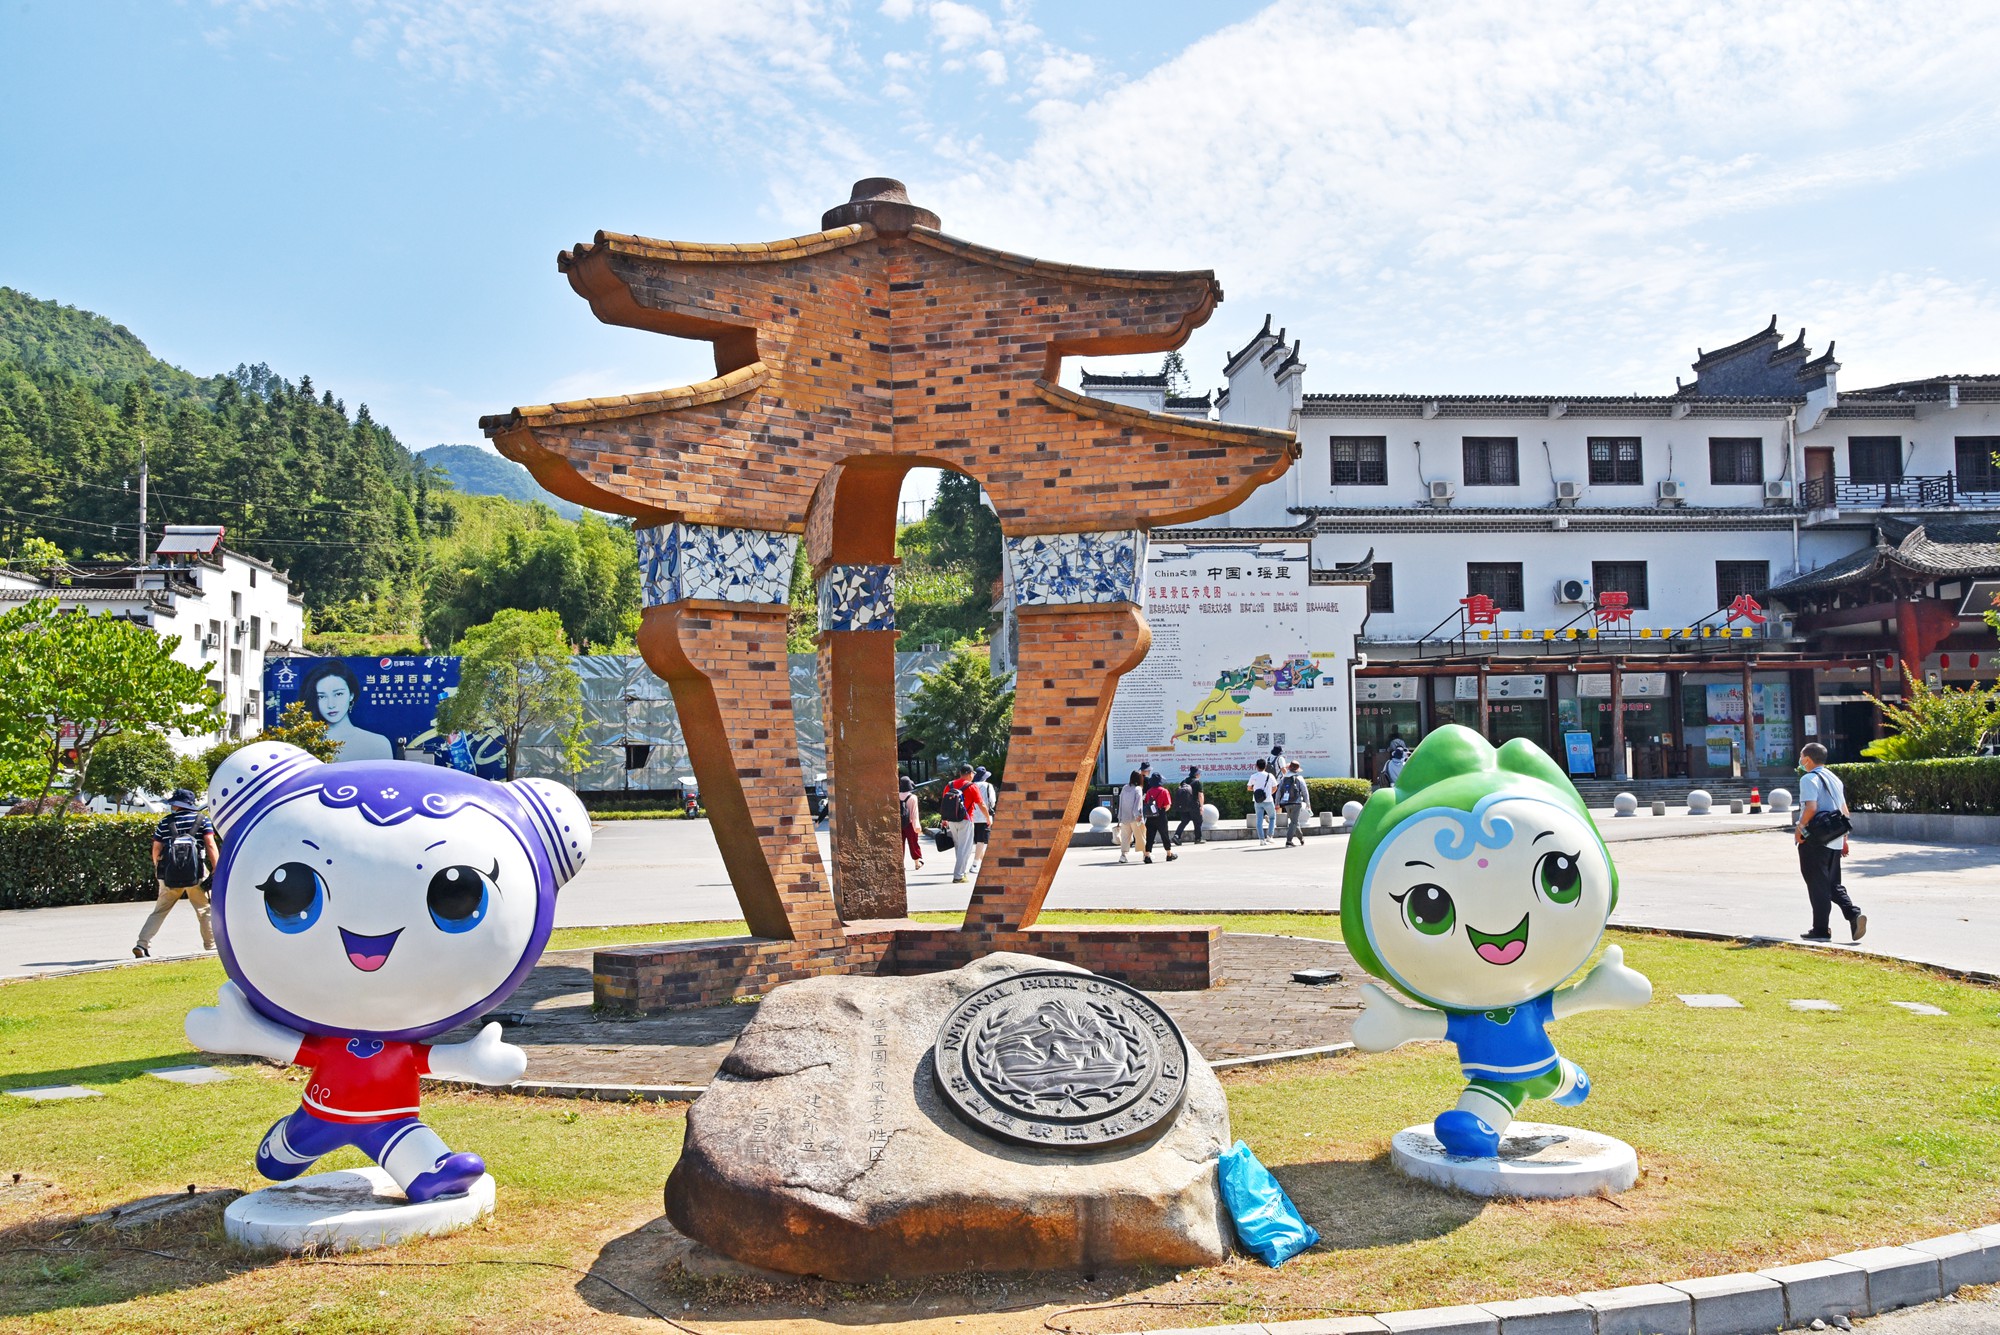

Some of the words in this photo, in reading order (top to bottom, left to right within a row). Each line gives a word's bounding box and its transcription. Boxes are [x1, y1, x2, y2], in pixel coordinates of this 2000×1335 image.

[1148, 586, 1222, 599] 瑶里景区示意图
[1459, 592, 1767, 624] 售票处
[1480, 628, 1598, 640] TICKET
[1640, 627, 1753, 639] OFFICE
[366, 674, 432, 684] 当澎湃百事
[944, 986, 1012, 1051] NATIONAL
[1020, 978, 1078, 990] PARK
[1086, 981, 1118, 998] OF
[1120, 997, 1171, 1040] CHINA
[951, 1060, 1180, 1141] 中国国家风景名胜区
